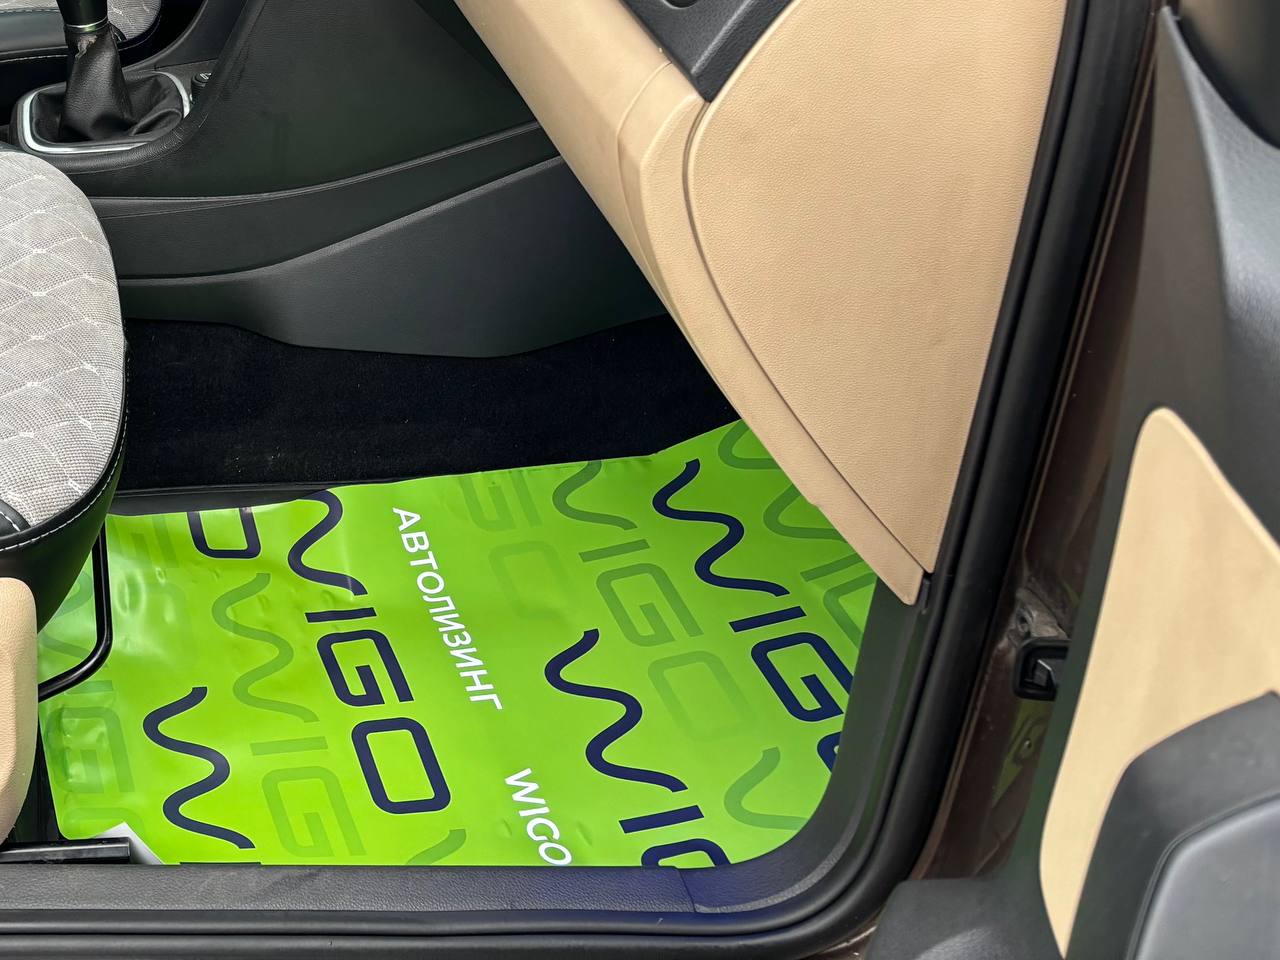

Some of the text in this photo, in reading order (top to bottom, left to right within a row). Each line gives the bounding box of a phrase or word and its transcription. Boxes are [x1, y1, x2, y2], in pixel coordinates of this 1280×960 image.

[392, 507, 572, 866] АВТОЛИЗИНГ WIGO
[652, 458, 854, 774] WIG
